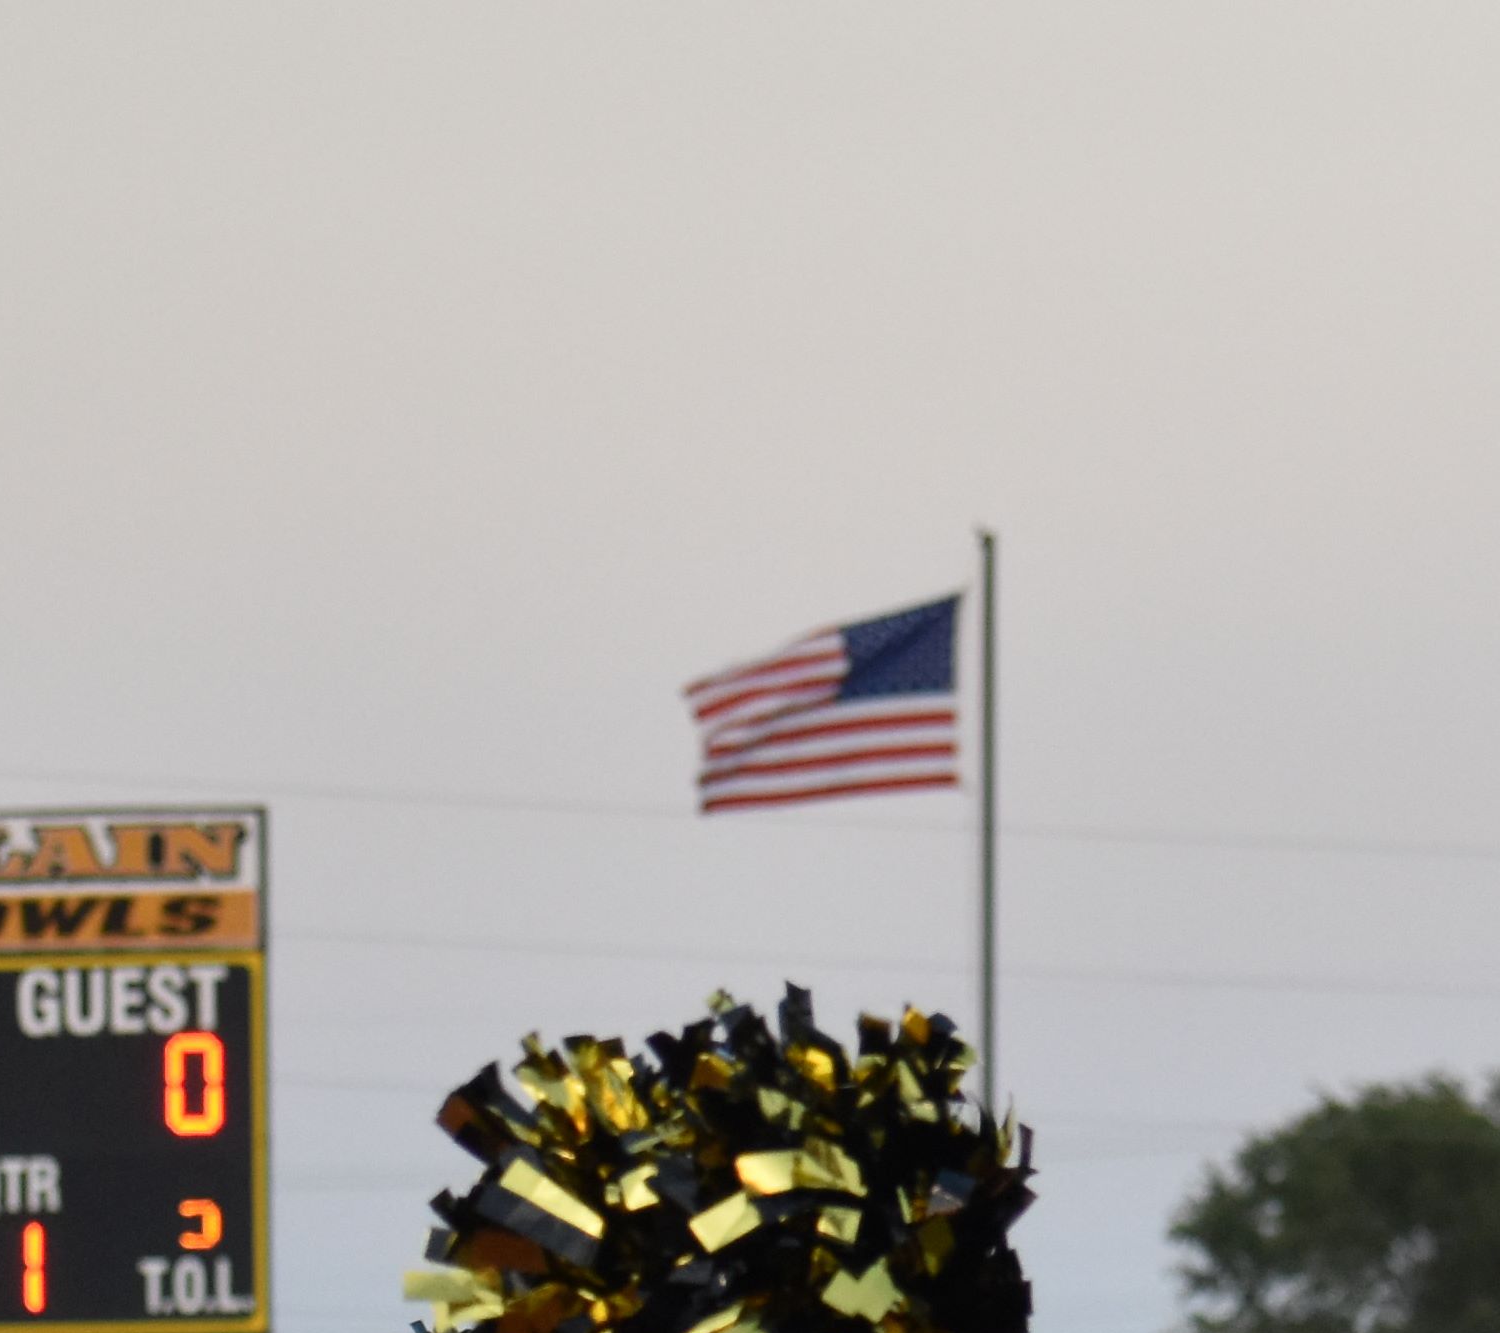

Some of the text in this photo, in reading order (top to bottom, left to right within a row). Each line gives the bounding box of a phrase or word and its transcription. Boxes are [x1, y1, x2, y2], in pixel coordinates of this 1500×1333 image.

[16, 965, 229, 1038] GUEST
[163, 1030, 225, 1137] 0
[22, 1220, 47, 1315] 1
[136, 1255, 256, 1316] T.O.L.
